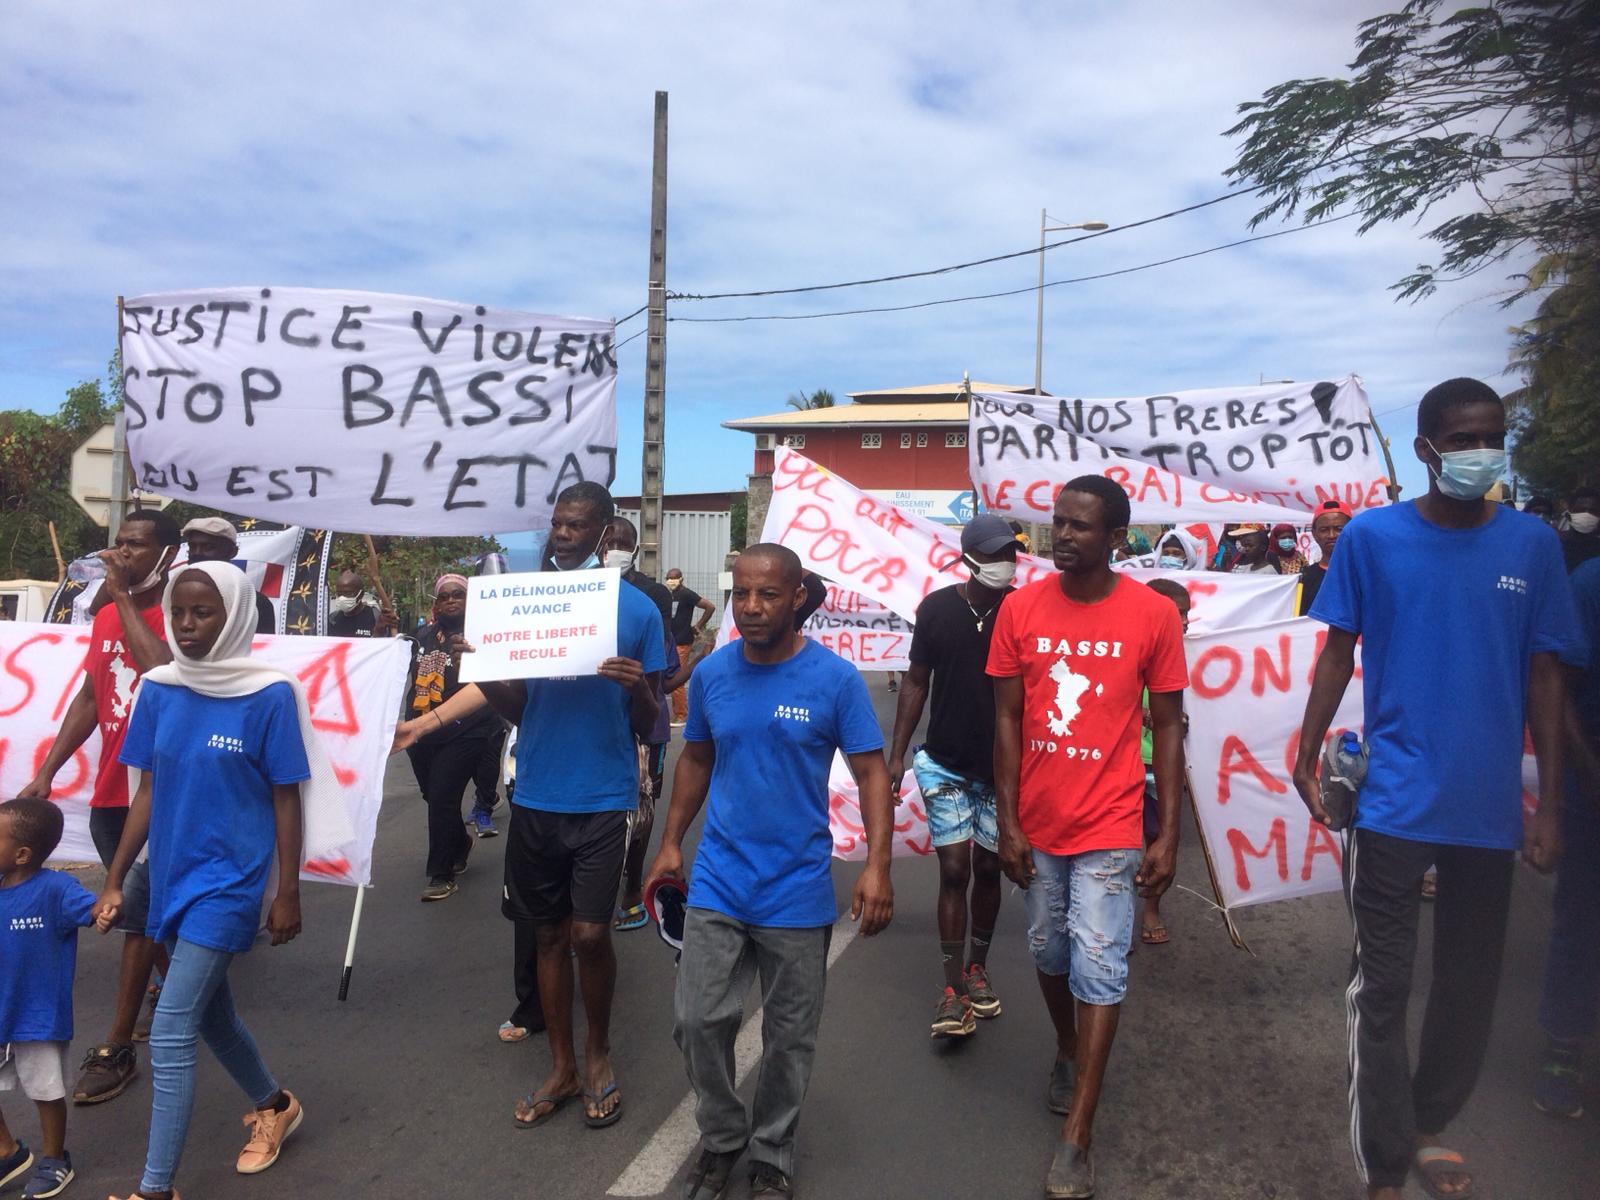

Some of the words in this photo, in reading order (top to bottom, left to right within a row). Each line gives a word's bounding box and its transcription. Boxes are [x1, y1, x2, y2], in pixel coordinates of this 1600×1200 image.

[123, 366, 282, 430] STOP
[1059, 399, 1132, 434] NOS
[1141, 433, 1288, 477] TROP
[226, 465, 333, 501] EST
[369, 441, 617, 511] L'ETAT
[895, 491, 911, 499] EAU
[980, 480, 1017, 511] LE
[779, 504, 908, 593] POUR
[480, 589, 498, 600] LA
[502, 581, 607, 598] DÉLINQUANCE
[511, 603, 572, 616] AVANCE
[482, 630, 531, 644] NOTRE
[536, 624, 598, 640] LIBERTÉ
[509, 647, 567, 661] RECULE
[1036, 637, 1122, 658] BASSI
[774, 711, 791, 719] IVO
[778, 704, 809, 716] BASSI
[207, 740, 224, 749] IVO
[211, 734, 243, 747] BASSI
[1030, 739, 1057, 753] IVO
[1066, 746, 1102, 761] 976
